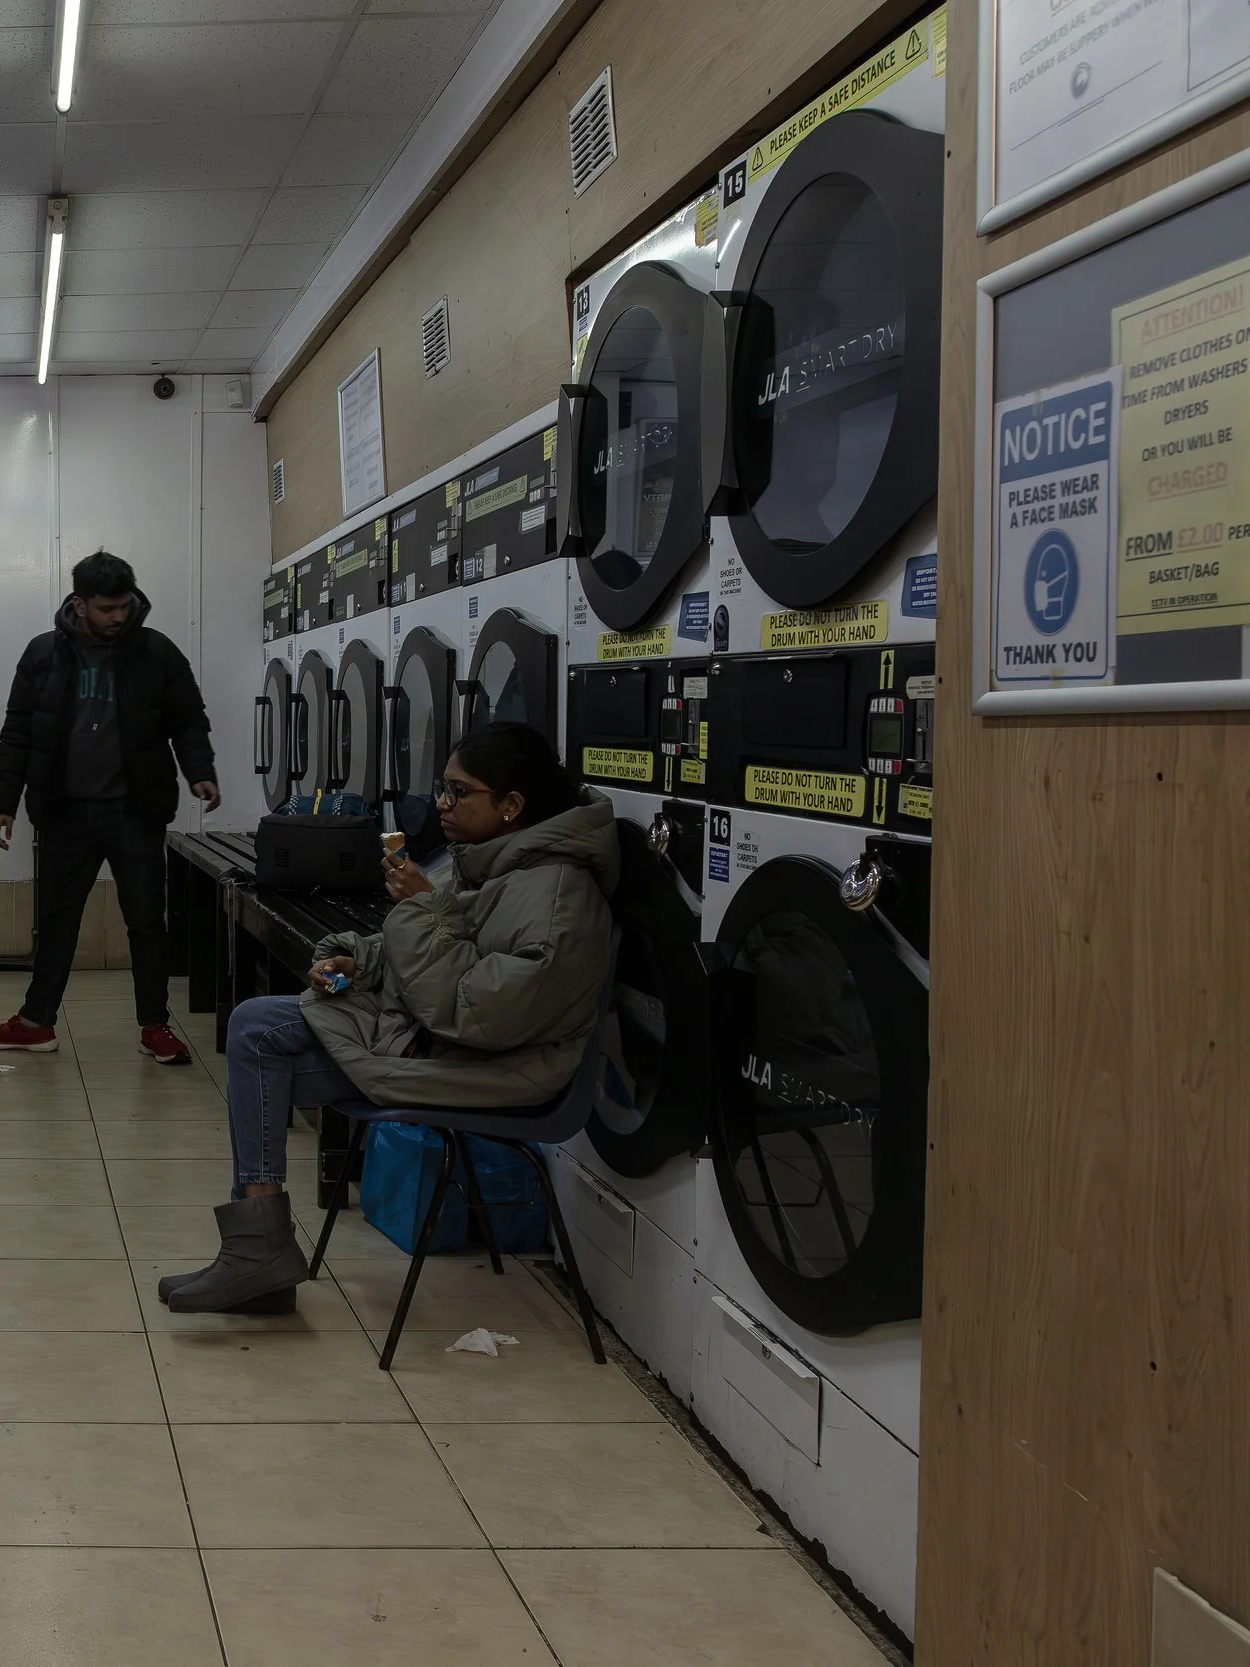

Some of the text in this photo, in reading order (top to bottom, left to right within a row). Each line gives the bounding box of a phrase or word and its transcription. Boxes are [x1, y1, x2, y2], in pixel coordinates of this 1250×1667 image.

[1008, 74, 1034, 97] FLOOR
[1036, 56, 1056, 76] MAY
[770, 49, 896, 154] PLEASE KEEP A SAFE DISTANCE
[727, 170, 743, 198] 15
[1141, 284, 1244, 341] ATTENTION!
[1129, 352, 1177, 380] REMOVE
[1179, 333, 1232, 363] CLOTHES
[758, 365, 790, 405] JLA
[1150, 378, 1185, 400] FROM
[1188, 358, 1248, 389] WASHERS
[1164, 400, 1209, 425] DRYERS
[1004, 401, 1107, 467] NOTICE
[1142, 426, 1233, 462] OR YOU WILL BE
[593, 447, 613, 475] JLA
[1008, 473, 1100, 508] PLEASE WEAR
[1147, 462, 1228, 497] CHARGED
[1010, 496, 1098, 529] A FACE MASK
[1126, 530, 1173, 556] FROM
[1229, 523, 1250, 540] PER
[720, 567, 742, 578] SHOES OR
[728, 558, 735, 566] NO
[916, 567, 937, 576] IMPORT
[1149, 561, 1220, 584] BASKET/BAG
[721, 578, 741, 588] CARPETS
[770, 604, 879, 630] PLEASE DO NOT TURN THE
[602, 634, 618, 646] PLEASE
[654, 628, 666, 640] THE
[771, 625, 876, 647] DRUM WITH YOUR HAND
[603, 643, 664, 659] DRUM WITH YOUR HAND
[1003, 641, 1097, 665] THANK YOU
[589, 750, 648, 765] PLEASE DO NOT TURN THE
[589, 763, 646, 779] DRUM WITH YOUR HAND
[753, 769, 856, 793] PLEASE DO NOT TURN THE
[755, 787, 853, 812] DRUM WITH YOUR HAND
[713, 816, 728, 838] 16
[744, 832, 751, 840] NO
[736, 842, 758, 853] SHOES OR
[737, 853, 757, 863] CARPETS
[741, 1053, 772, 1090] JLA
